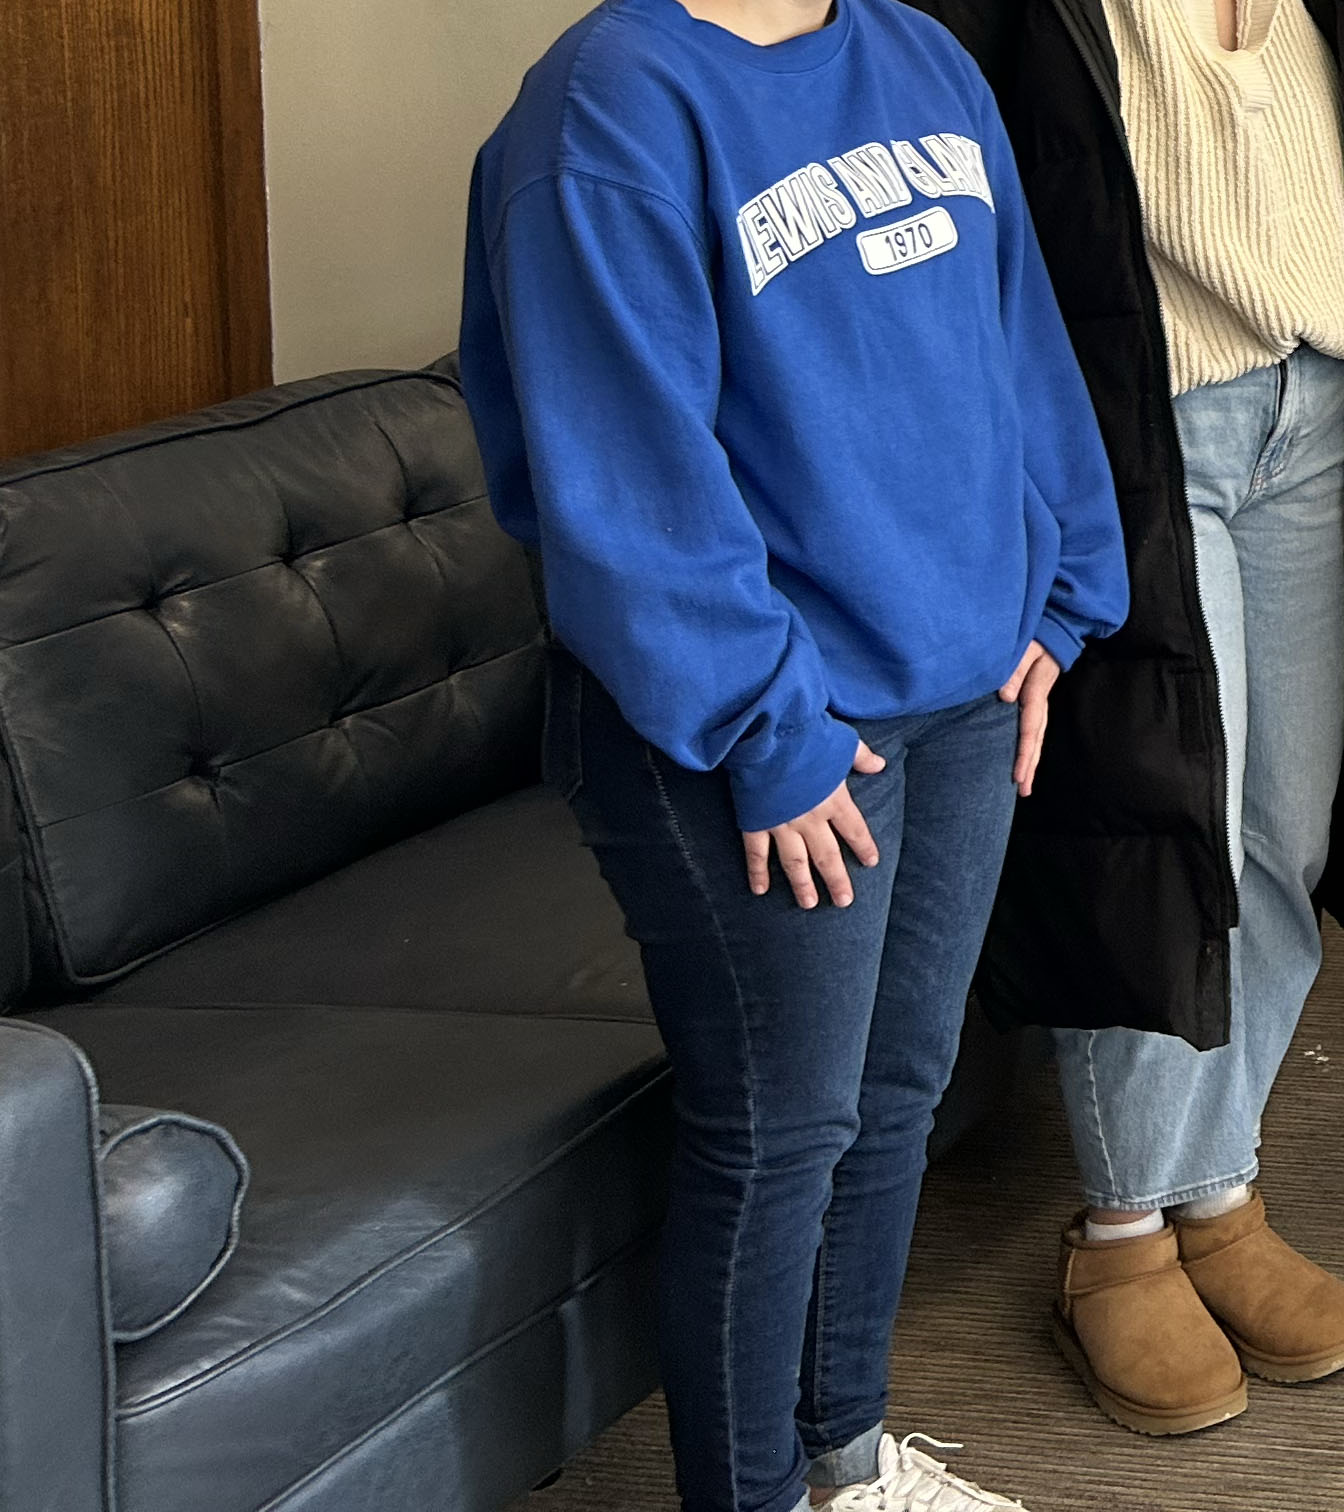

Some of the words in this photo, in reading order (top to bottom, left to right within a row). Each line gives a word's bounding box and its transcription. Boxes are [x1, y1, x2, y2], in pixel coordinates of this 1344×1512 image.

[736, 161, 857, 296] LEWIS
[826, 141, 913, 219] AND
[884, 222, 934, 262] 1970
